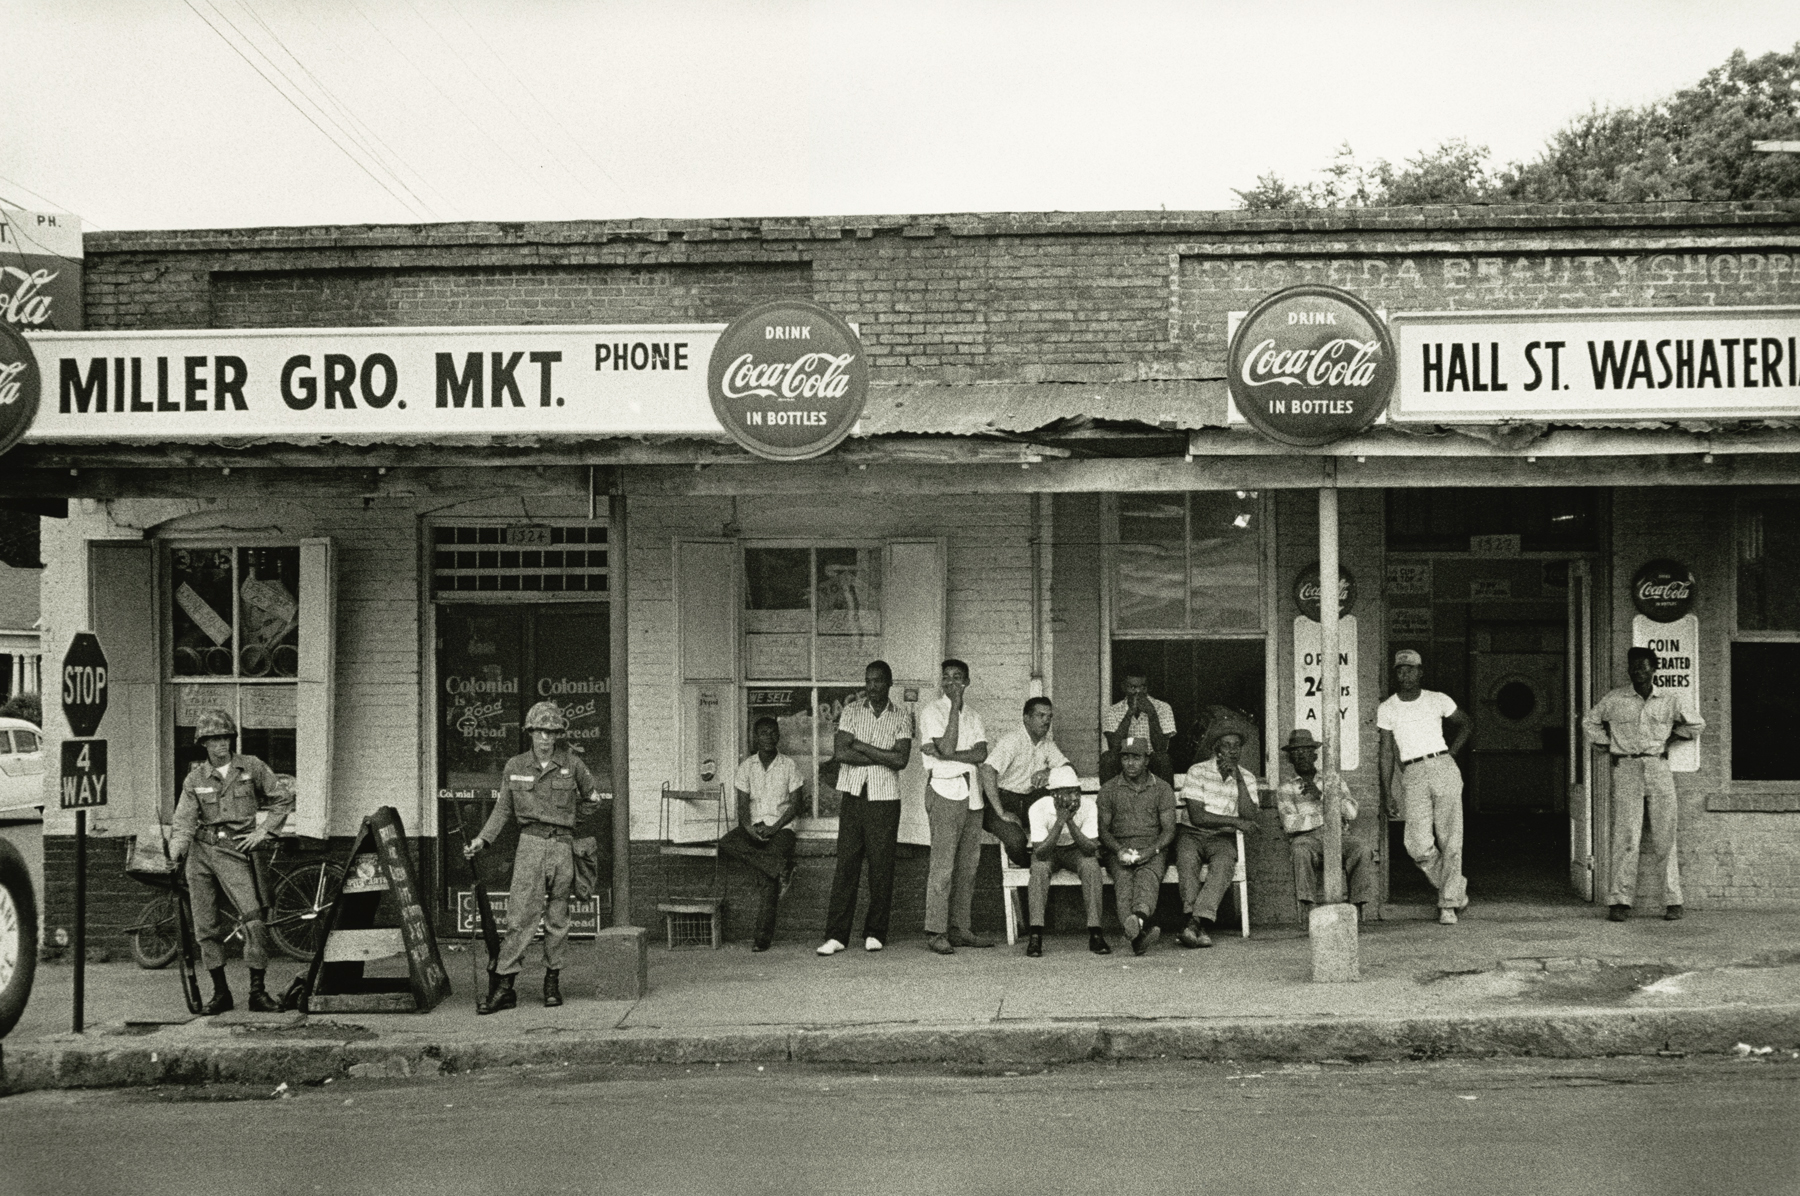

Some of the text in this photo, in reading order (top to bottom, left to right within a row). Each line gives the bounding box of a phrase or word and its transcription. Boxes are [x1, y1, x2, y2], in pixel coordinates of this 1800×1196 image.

[1288, 311, 1337, 326] DRINK
[765, 325, 811, 340] DRINK
[1242, 338, 1382, 388] Coca-Cola
[1423, 342, 1508, 392] HALL
[1524, 340, 1571, 391] ST.
[59, 342, 689, 413] MILLER GRO. MKT. PHONE
[721, 352, 856, 399] Coca-Cola
[1269, 399, 1354, 415] IN BOTTLES
[746, 410, 828, 426] IN BOTTLES
[1639, 581, 1691, 600] Coca-Cola
[1648, 639, 1680, 652] COIN
[1304, 652, 1348, 666] OPN
[1656, 657, 1691, 669] ERATED
[64, 665, 107, 705] STOP
[446, 675, 518, 695] Colonial
[537, 676, 612, 697] Colonial
[1653, 675, 1690, 688] ASHERS
[766, 691, 793, 703] SELL
[463, 725, 506, 738] Bread
[76, 743, 91, 772] 4
[63, 774, 106, 806] WAY
[569, 918, 595, 928] read
